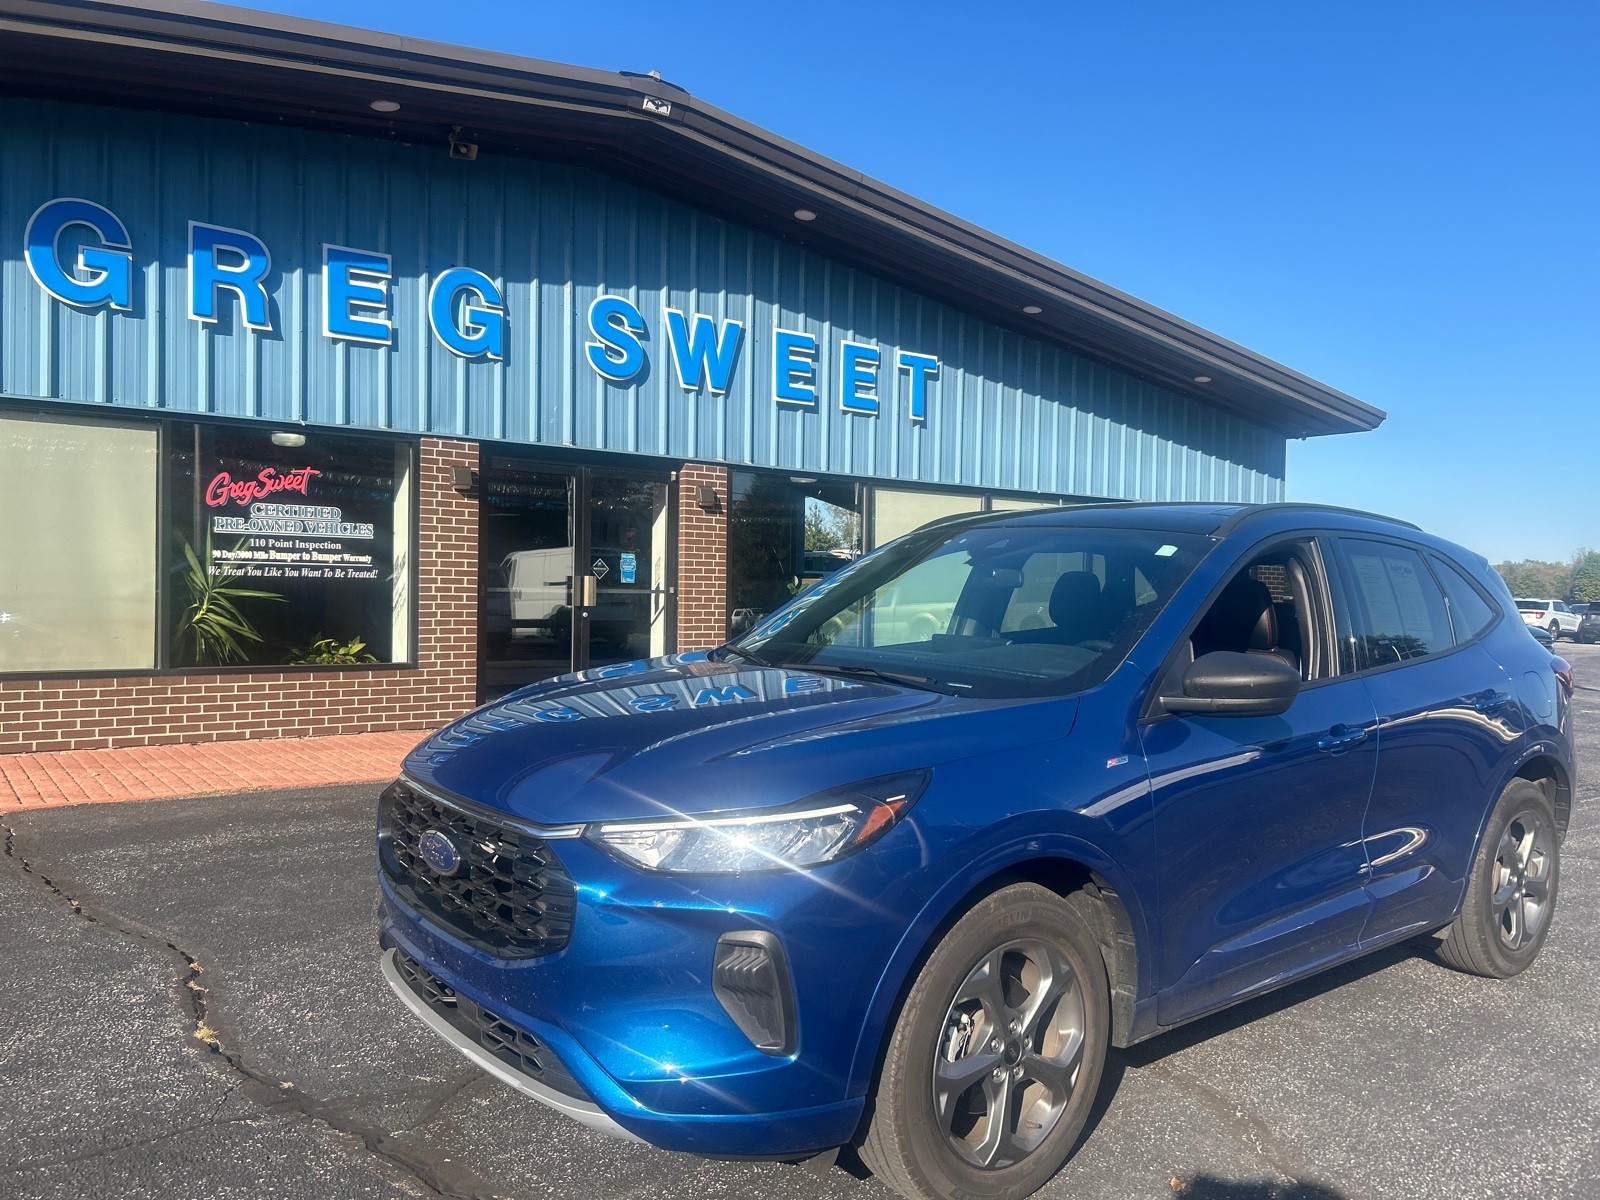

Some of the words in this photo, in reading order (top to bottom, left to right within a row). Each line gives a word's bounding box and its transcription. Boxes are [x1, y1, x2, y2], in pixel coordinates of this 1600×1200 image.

[24, 197, 504, 360] GREG
[585, 294, 938, 421] SWEET
[251, 502, 342, 519] CERTIFIED
[214, 516, 304, 533] PRE-OWNED
[306, 521, 374, 536] VEHICLES
[250, 538, 266, 547] 110
[268, 539, 293, 549] Point
[295, 540, 342, 551] Inspection
[269, 550, 301, 563] Bumper
[302, 551, 311, 561] to
[311, 551, 343, 564] Bumper
[343, 553, 372, 564] Warranty
[208, 565, 221, 576] We
[223, 565, 245, 577] Treat
[247, 566, 263, 577] You
[264, 566, 283, 577] Like
[285, 567, 300, 577] You
[301, 567, 322, 578] Want
[323, 568, 333, 578] To
[334, 568, 346, 578] Be
[347, 568, 379, 579] Treated!
